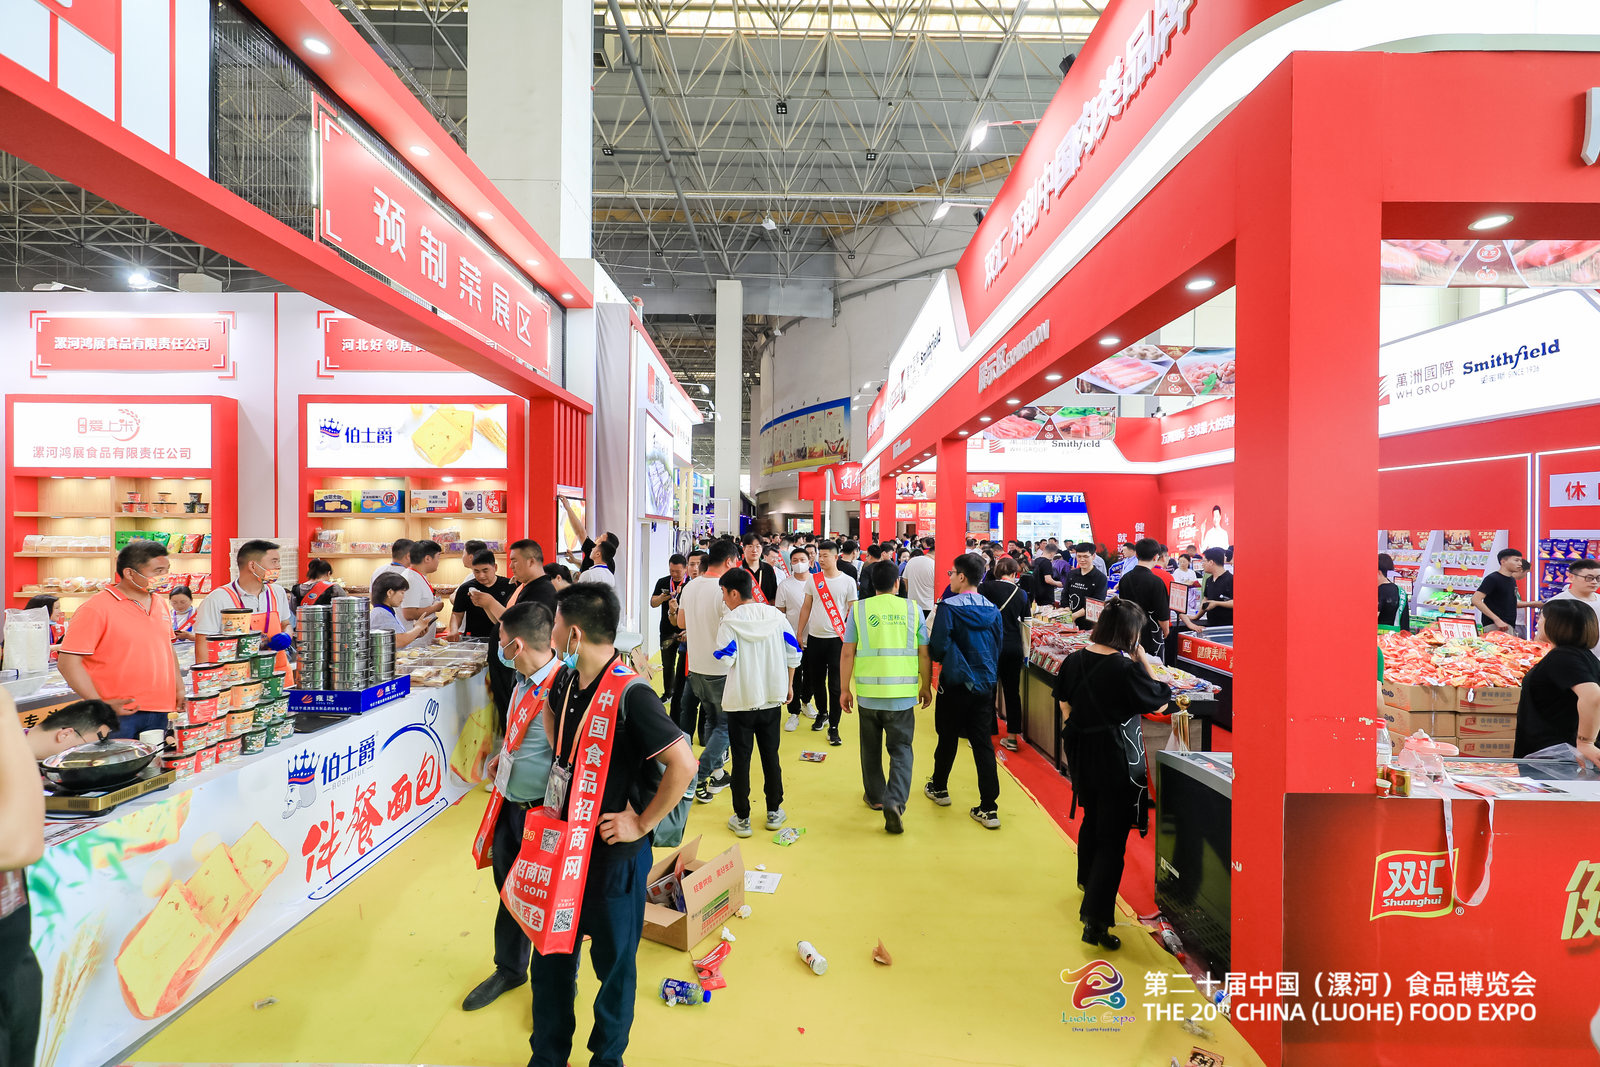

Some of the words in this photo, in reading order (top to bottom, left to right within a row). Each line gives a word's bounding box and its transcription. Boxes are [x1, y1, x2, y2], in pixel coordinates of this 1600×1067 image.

[374, 186, 532, 347] 预制菜展区
[54, 336, 210, 351] 漯河鸿展食品有限责任公司
[1463, 338, 1561, 376] Smithfield
[1396, 360, 1454, 388] 萬洲國際
[1396, 388, 1413, 399] WH
[1416, 379, 1456, 396] GROUP
[345, 426, 393, 443] 伯士爵
[1051, 440, 1100, 450] Smithfield
[33, 446, 191, 460] 漯河鸿展食品有限责任公司
[1197, 646, 1227, 661] 健康美味
[321, 734, 375, 786] 伯士爵
[562, 689, 615, 880] 中国食品招商网
[302, 752, 442, 883] 伴餐面包
[1383, 859, 1446, 897] 双汇
[1382, 896, 1442, 908] Shuanghui
